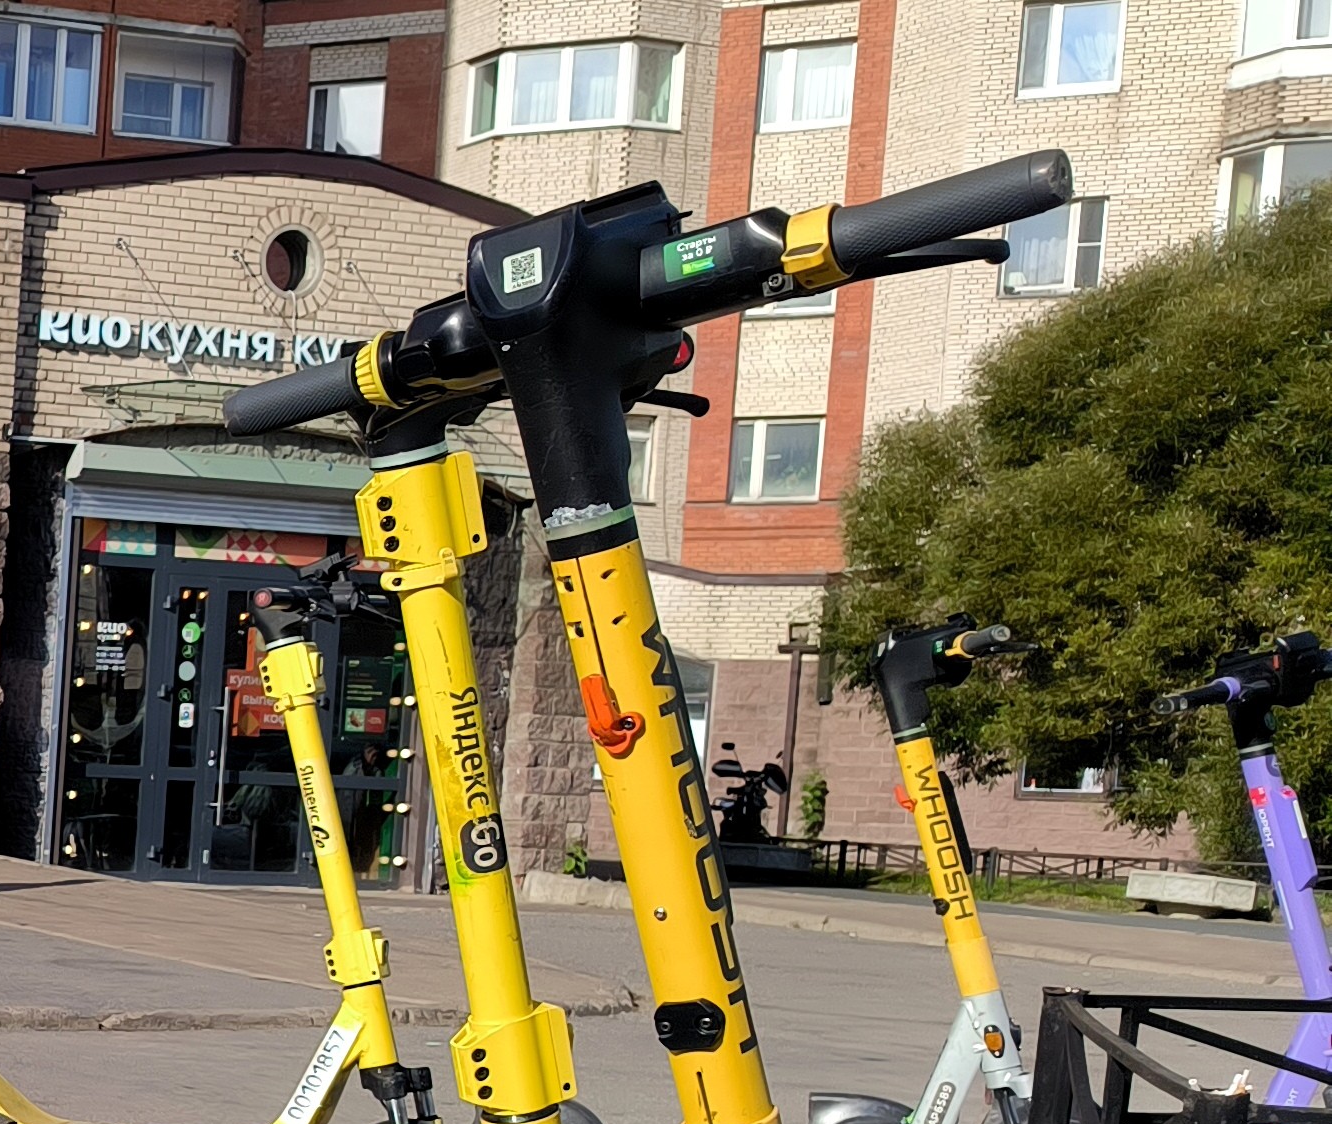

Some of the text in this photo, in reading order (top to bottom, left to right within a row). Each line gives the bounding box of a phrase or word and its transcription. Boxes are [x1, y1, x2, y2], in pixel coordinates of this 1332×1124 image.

[677, 236, 717, 251] Старты
[681, 252, 694, 262] за
[140, 318, 276, 364] кухня
[299, 765, 320, 824] Яндекс
[448, 686, 501, 868] Яндекс Go
[914, 764, 974, 921] WHOOSH
[287, 1029, 345, 1120] 00101857
